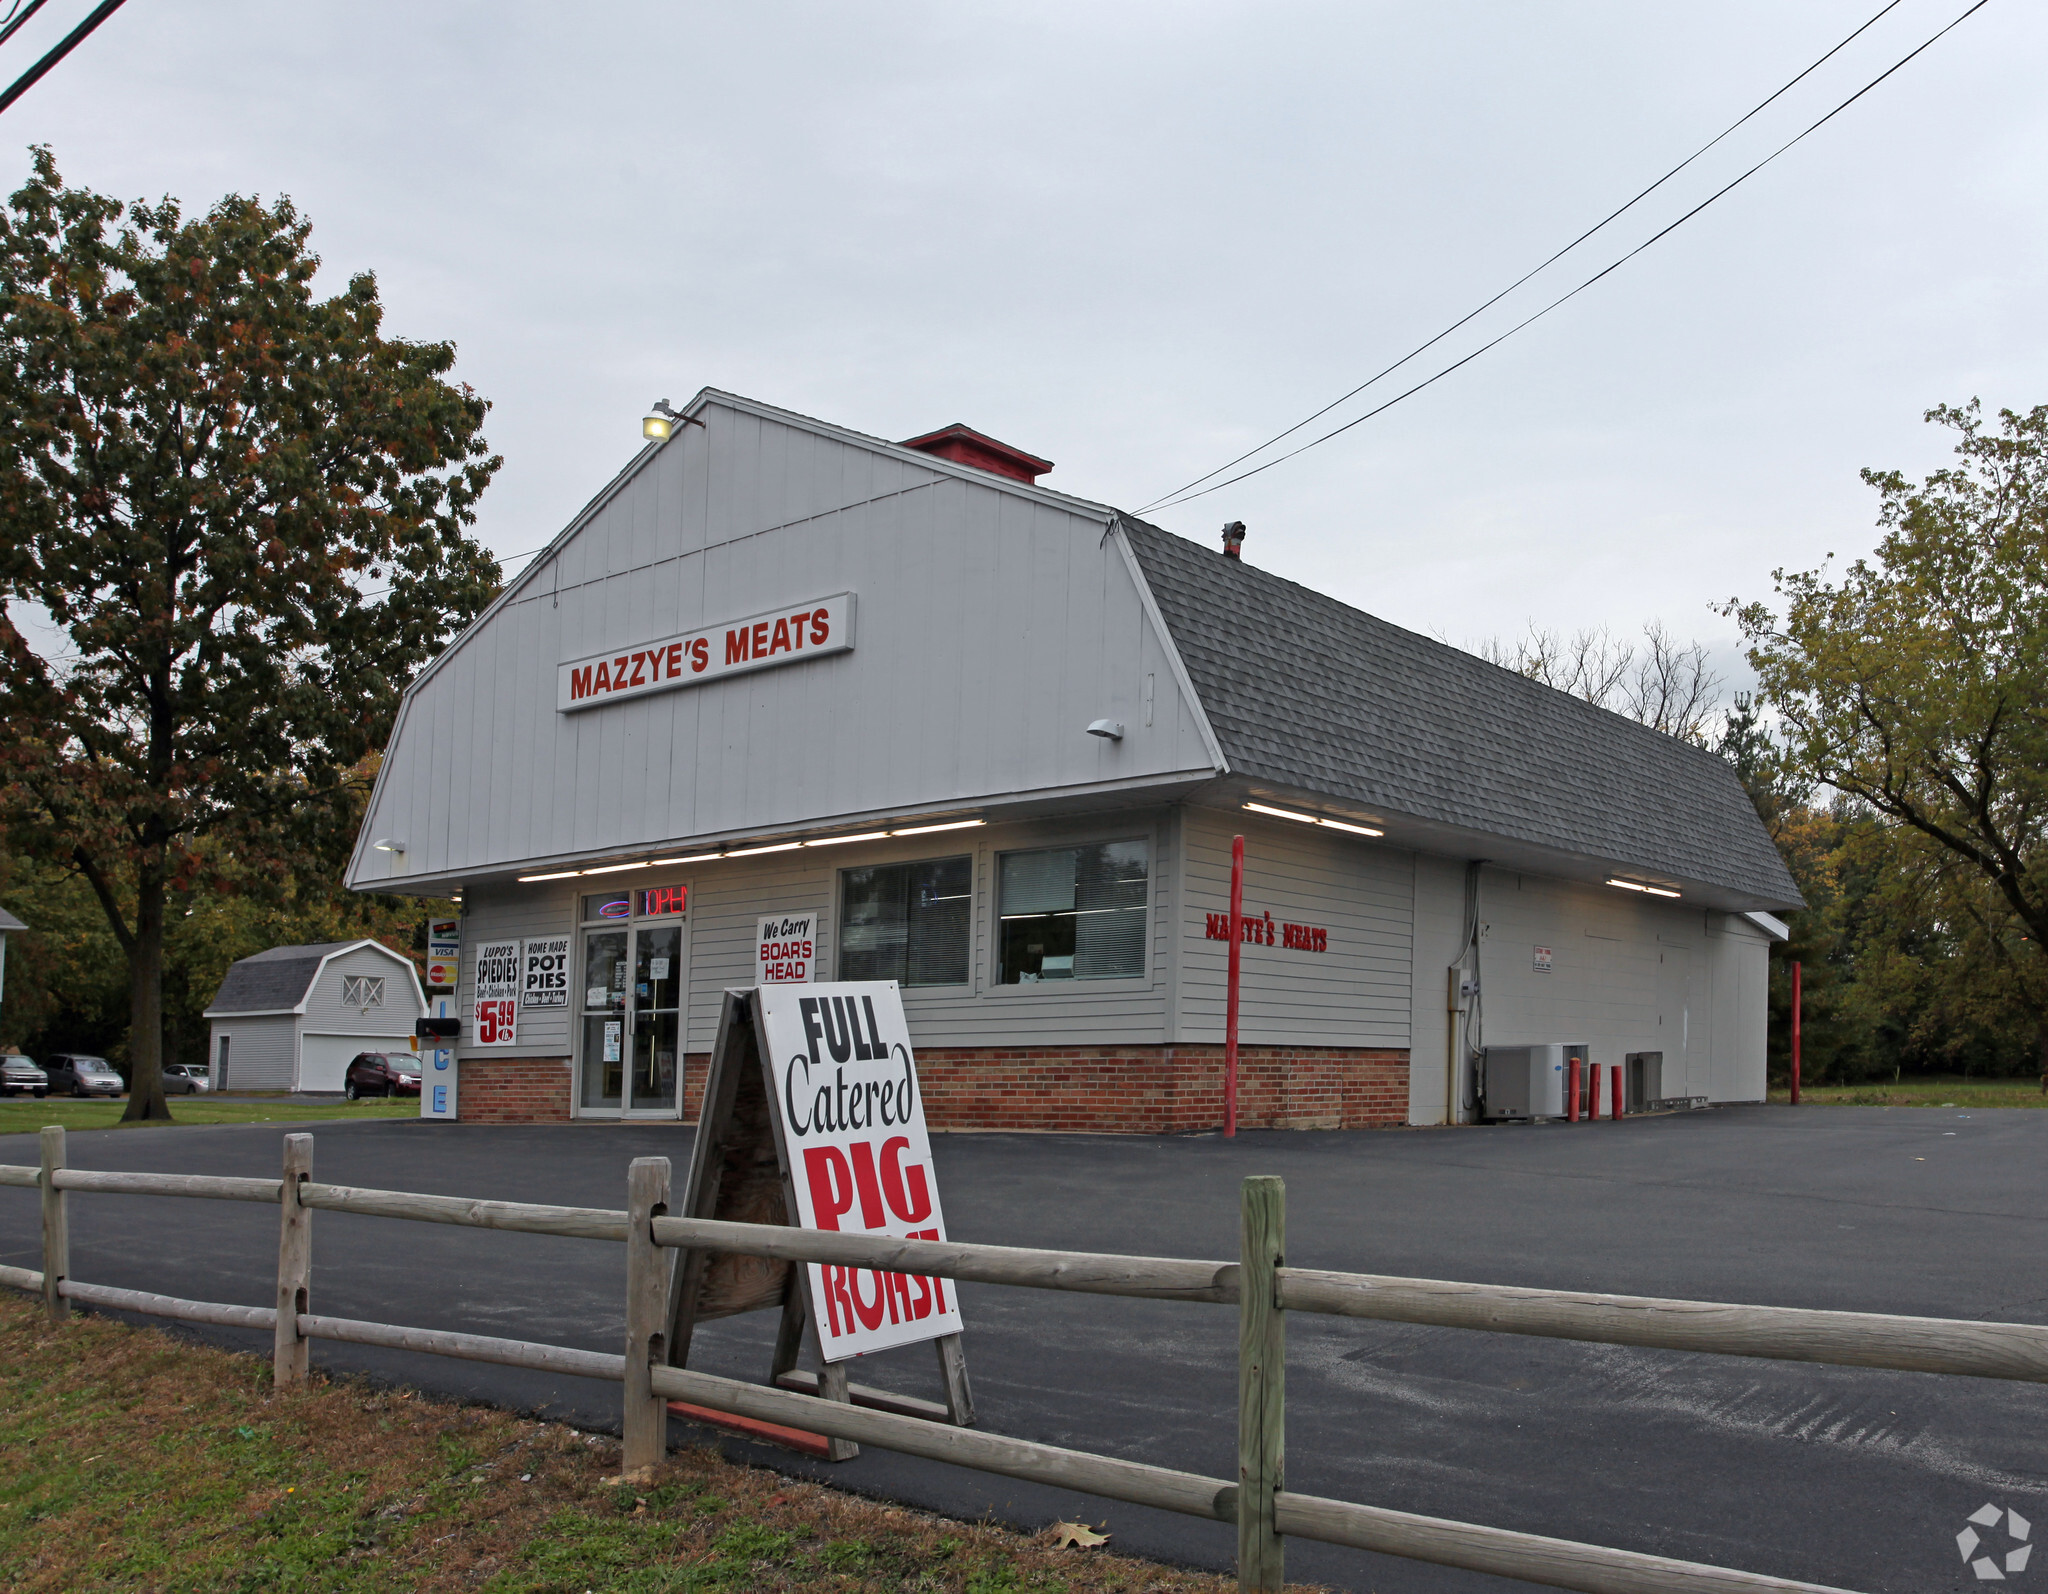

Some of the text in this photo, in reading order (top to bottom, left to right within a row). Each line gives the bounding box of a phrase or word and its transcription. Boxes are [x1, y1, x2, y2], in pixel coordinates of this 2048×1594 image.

[571, 608, 830, 701] MAZZYE'S MEATS
[763, 918, 810, 940] We Carry
[1205, 910, 1328, 952] MAYE'S MEATS
[435, 948, 454, 956] VISA
[484, 946, 513, 958] LUPO'S
[528, 941, 568, 954] HOME MADE
[761, 939, 812, 960] BOAR'S
[478, 958, 517, 984] SPIEDIES
[528, 955, 566, 972] POT
[765, 961, 805, 980] HEAD
[488, 984, 505, 998] Chicken
[527, 972, 566, 989] PIES
[799, 995, 889, 1064] FULL
[785, 1043, 913, 1136] Catered
[803, 1136, 932, 1232] PIG
